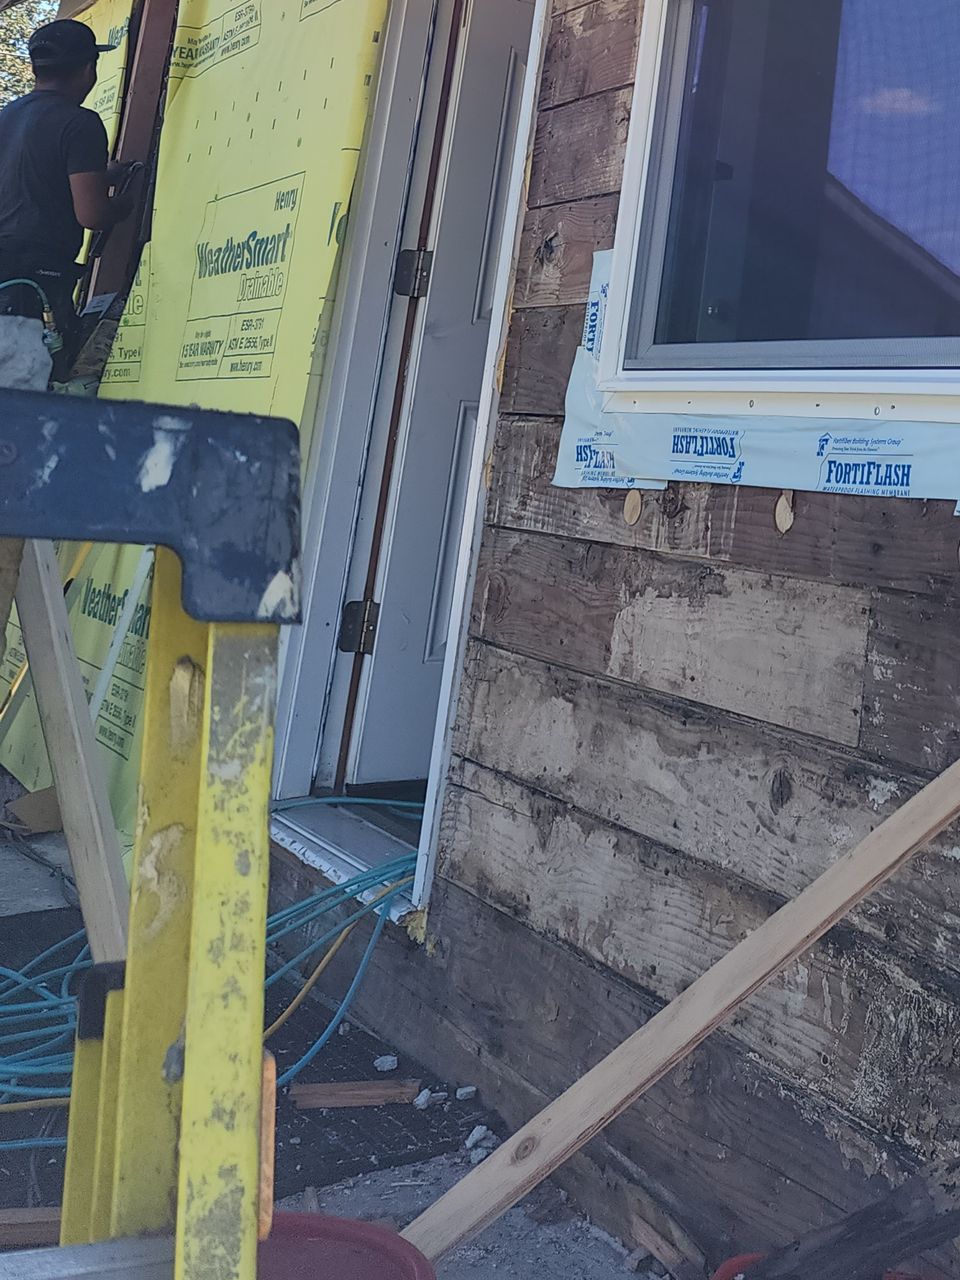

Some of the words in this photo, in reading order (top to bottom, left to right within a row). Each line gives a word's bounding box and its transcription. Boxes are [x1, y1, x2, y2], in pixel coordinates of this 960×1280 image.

[274, 188, 298, 212] Henry
[197, 223, 290, 279] WeatherSmart
[118, 347, 137, 361] Type
